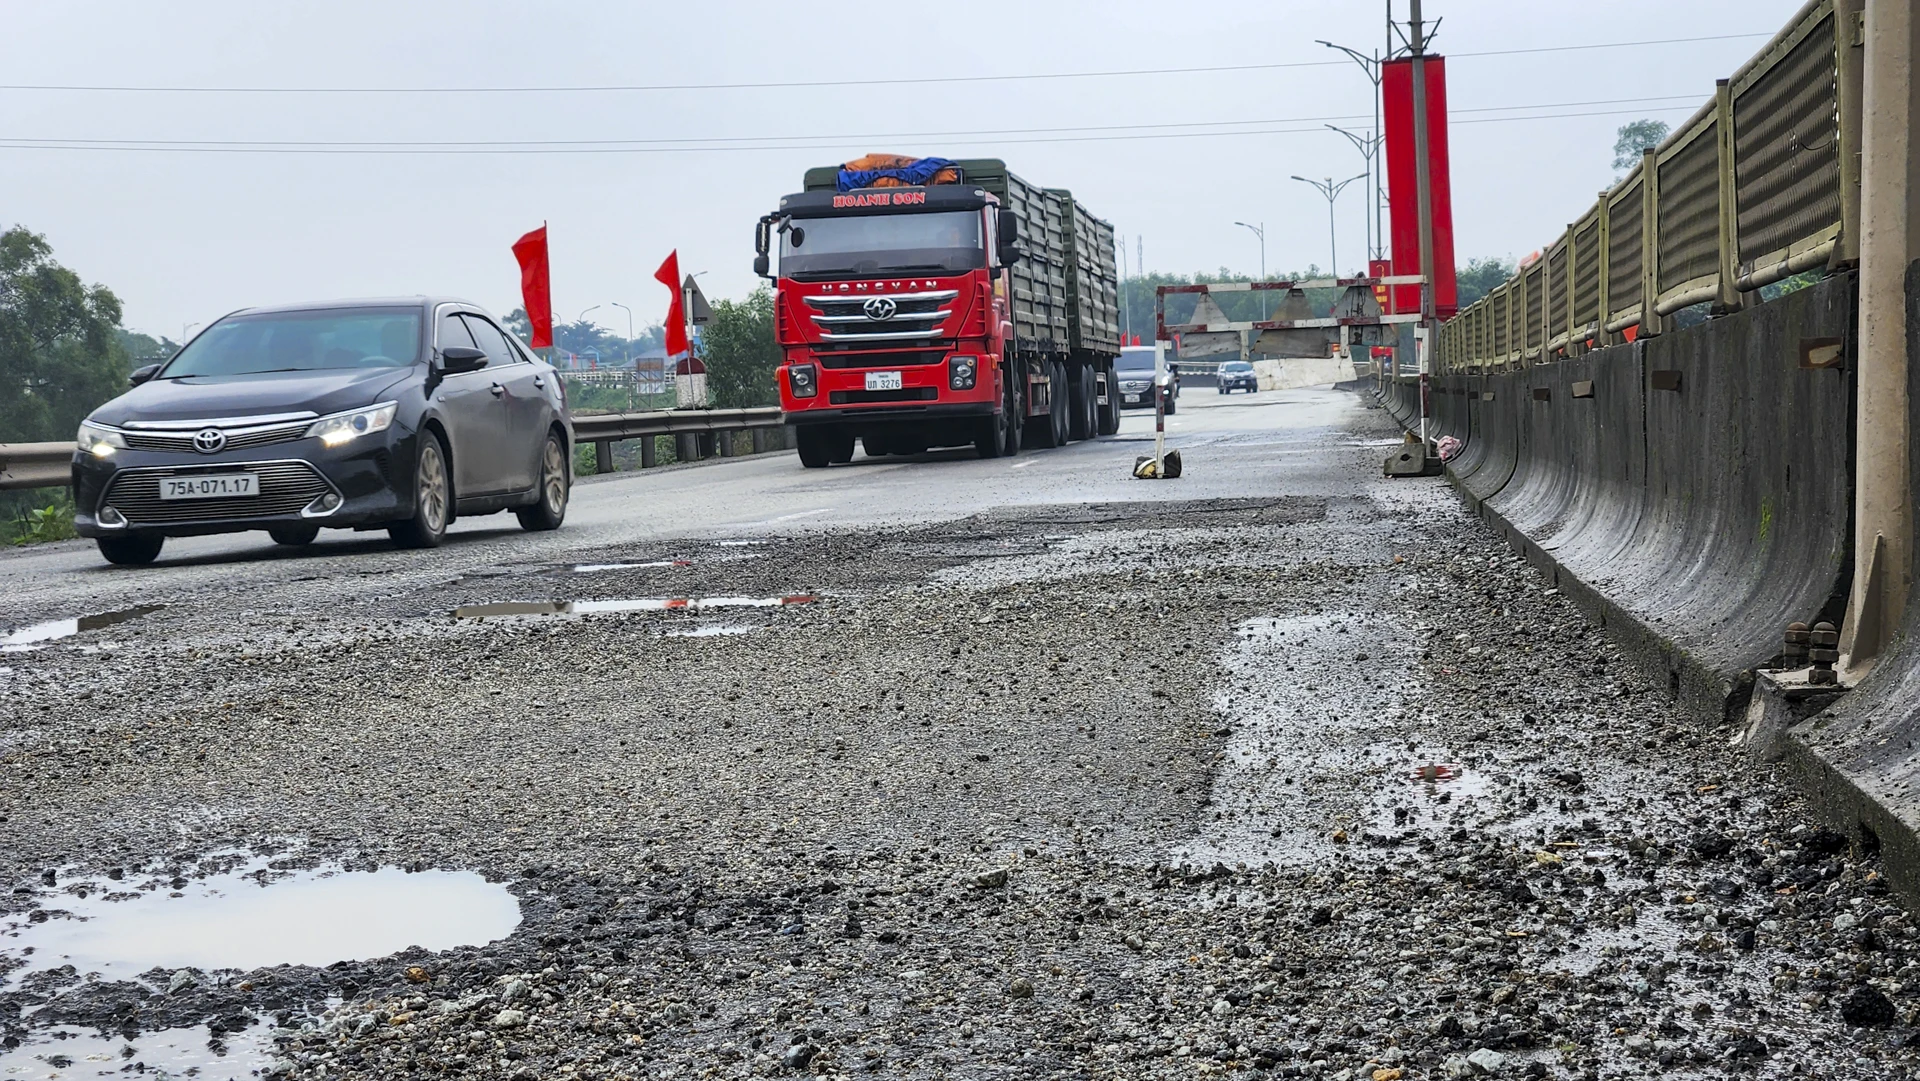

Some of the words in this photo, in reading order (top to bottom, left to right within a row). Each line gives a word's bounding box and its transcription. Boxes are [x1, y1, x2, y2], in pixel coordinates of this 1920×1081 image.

[833, 193, 891, 208] HOANH
[893, 191, 926, 205] SON
[822, 280, 937, 292] HONGYAN
[880, 379, 901, 389] 3276
[168, 478, 250, 496] 75A-071.17
